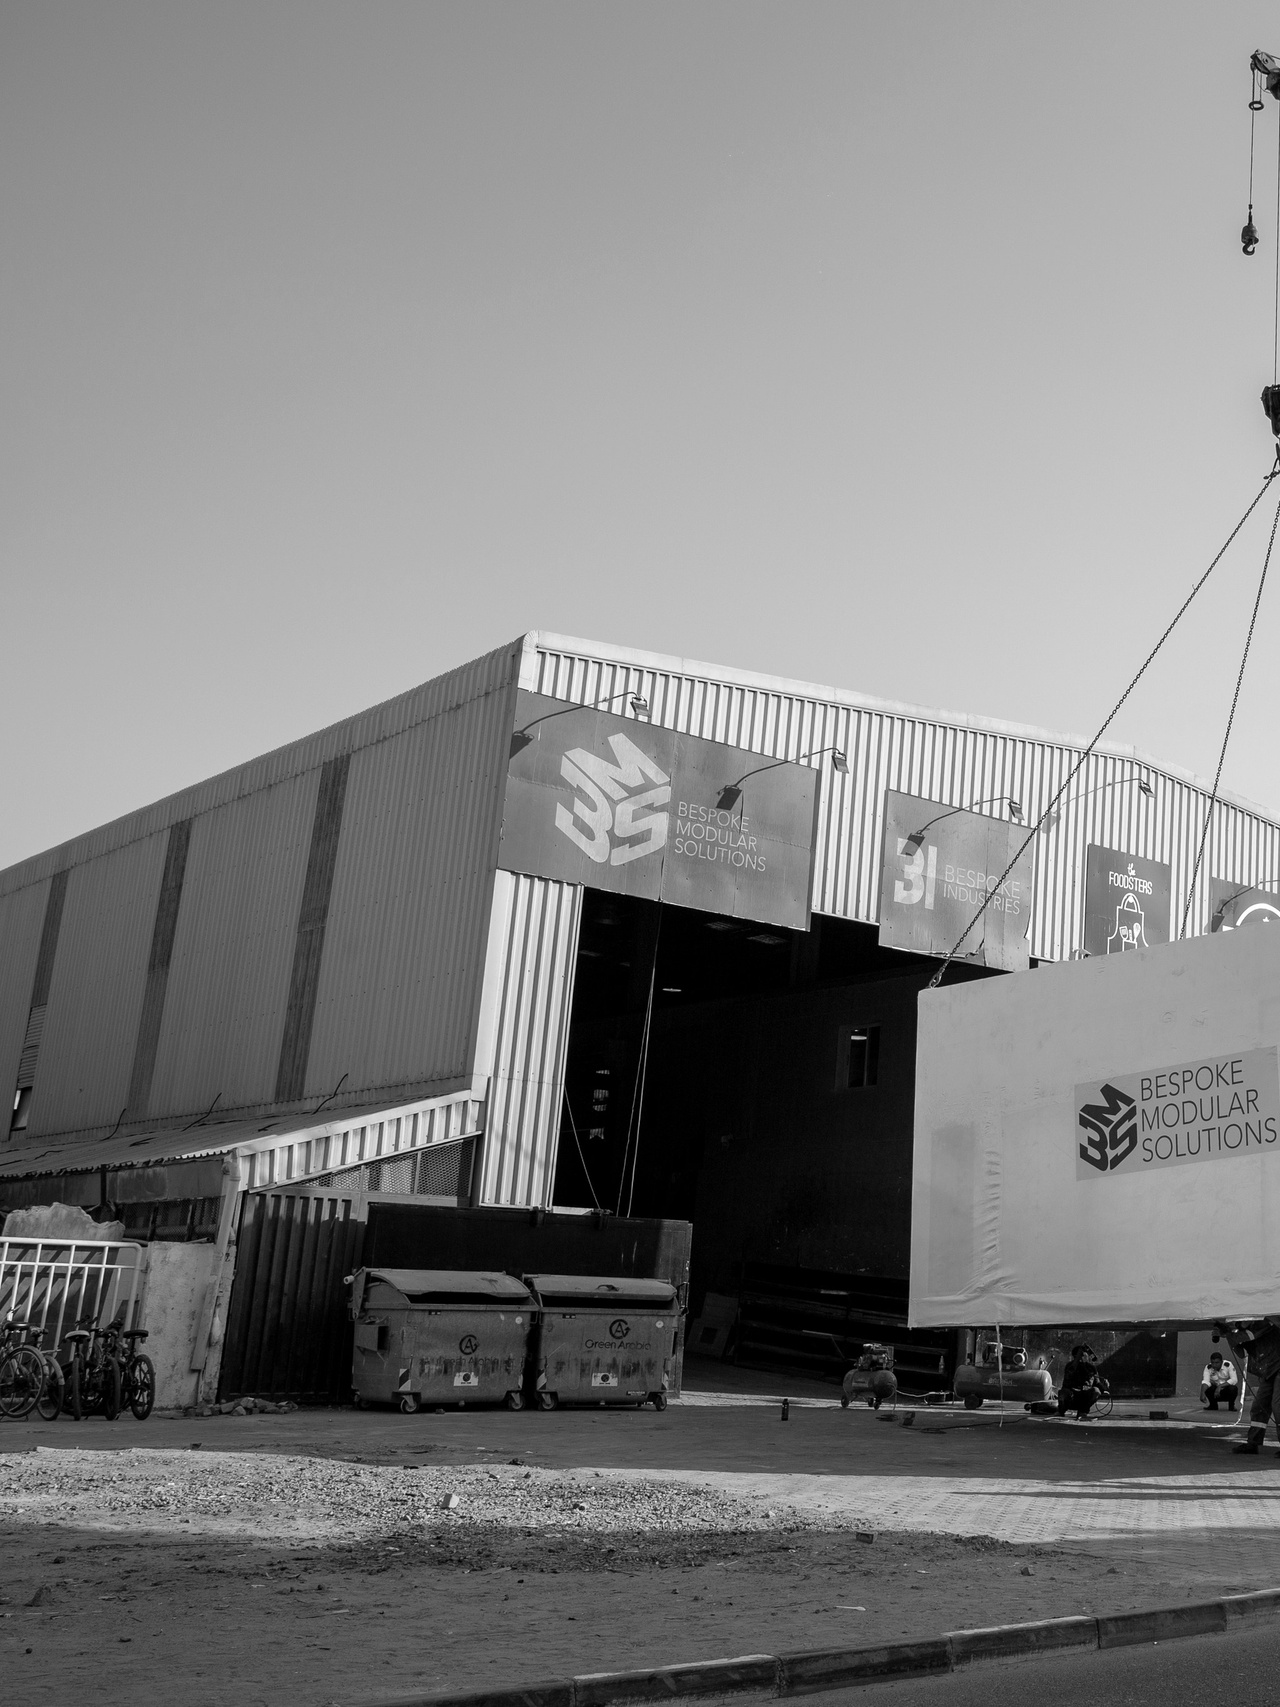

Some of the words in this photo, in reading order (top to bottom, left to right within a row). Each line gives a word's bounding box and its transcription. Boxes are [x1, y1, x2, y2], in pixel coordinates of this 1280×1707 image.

[678, 801, 750, 832] BESPOKE
[676, 819, 758, 852] MODULAR
[674, 837, 767, 872] SOLUTIONS
[1127, 862, 1136, 876] the
[945, 864, 1021, 899] BESPOKE
[1108, 871, 1153, 895] FOODSTERS
[943, 883, 1020, 915] INDUSTRIES
[1140, 1059, 1244, 1102] BESPOKE
[1141, 1089, 1260, 1132] MODULAR
[1142, 1117, 1278, 1163] SOLUTIONS
[584, 1339, 616, 1349] Green
[617, 1340, 652, 1350] Arabia
